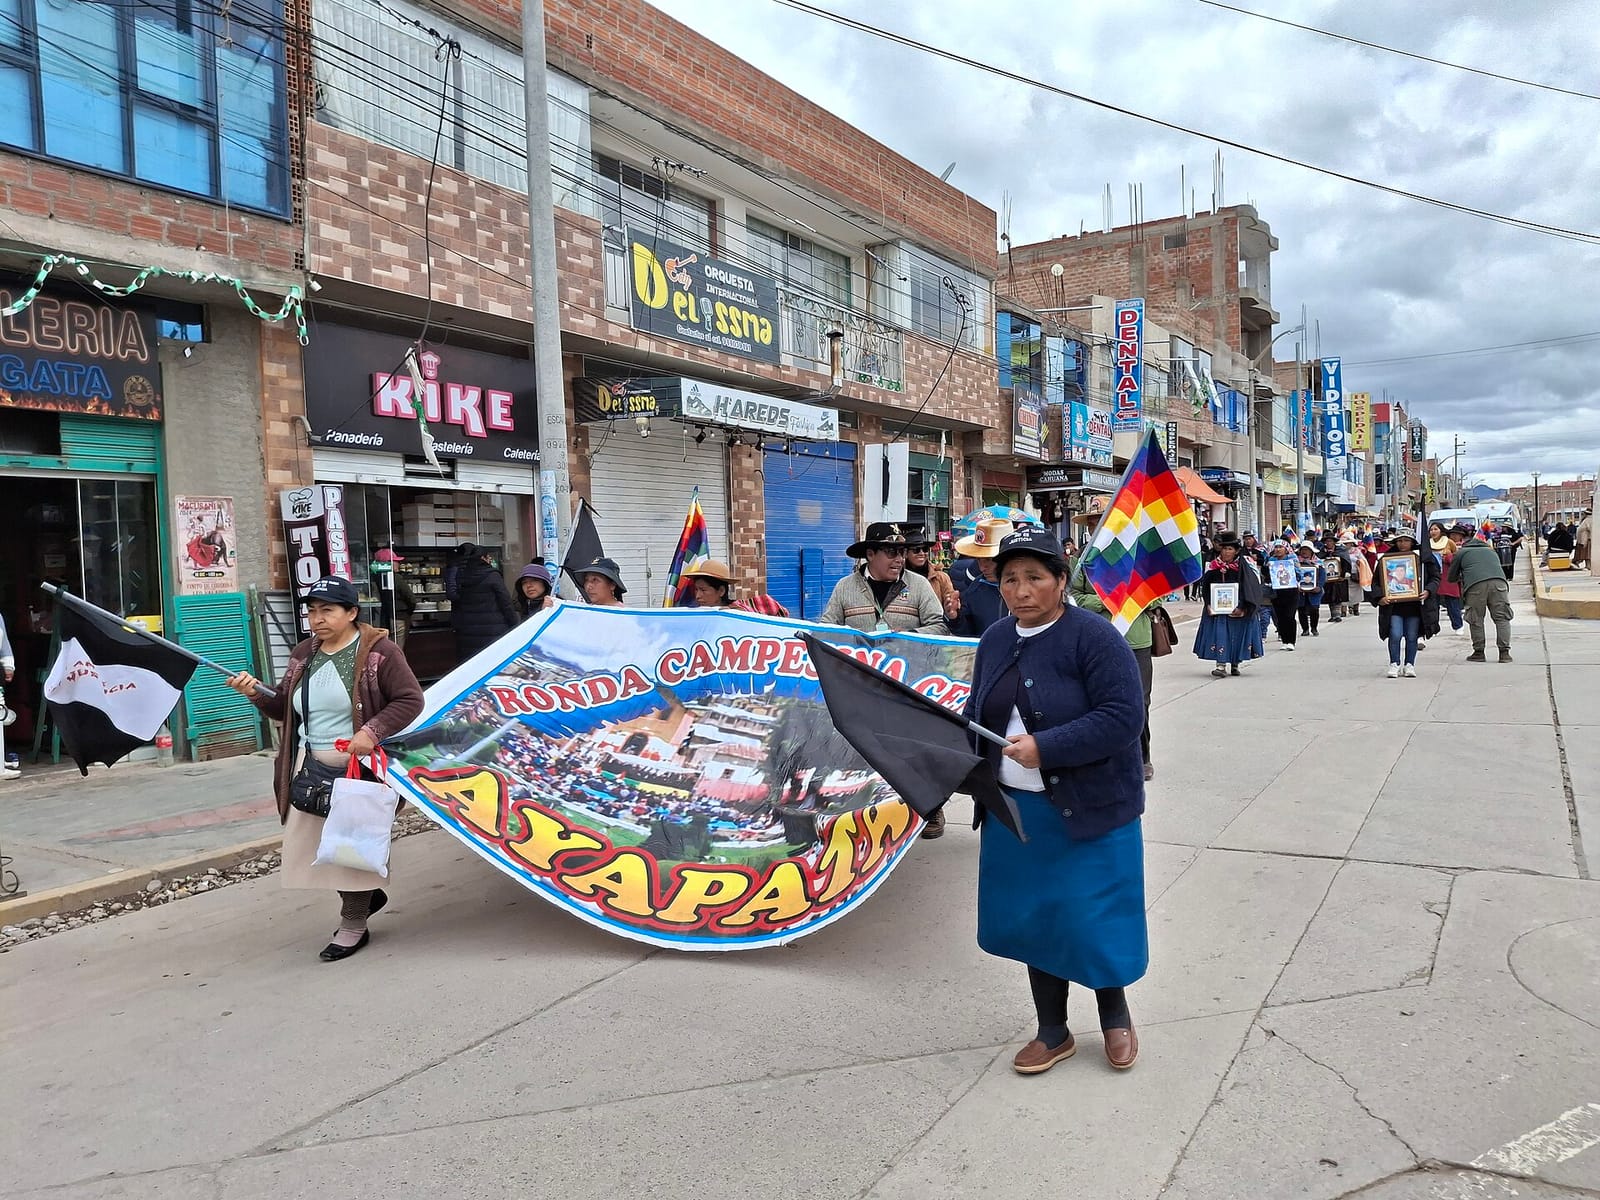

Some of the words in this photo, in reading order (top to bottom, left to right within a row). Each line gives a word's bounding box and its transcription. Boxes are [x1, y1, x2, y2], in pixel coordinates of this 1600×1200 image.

[704, 264, 755, 293] ORQUESTA
[0, 289, 148, 361] LERIA
[1116, 308, 1140, 410] DENTAL
[0, 355, 112, 399] GATA
[1323, 362, 1344, 456] VIDRIOS
[1353, 394, 1367, 446] HOSPEDAJE
[326, 429, 384, 447] Panadería
[1088, 420, 1111, 438] DENTAL
[1168, 422, 1177, 463] HOSPEDAJE
[431, 440, 474, 456] astelería
[1040, 475, 1069, 483] CAHUANA
[1043, 469, 1065, 477] MODAS
[291, 502, 313, 516] KIKE
[491, 666, 652, 717] RONDA
[911, 675, 971, 716] CE
